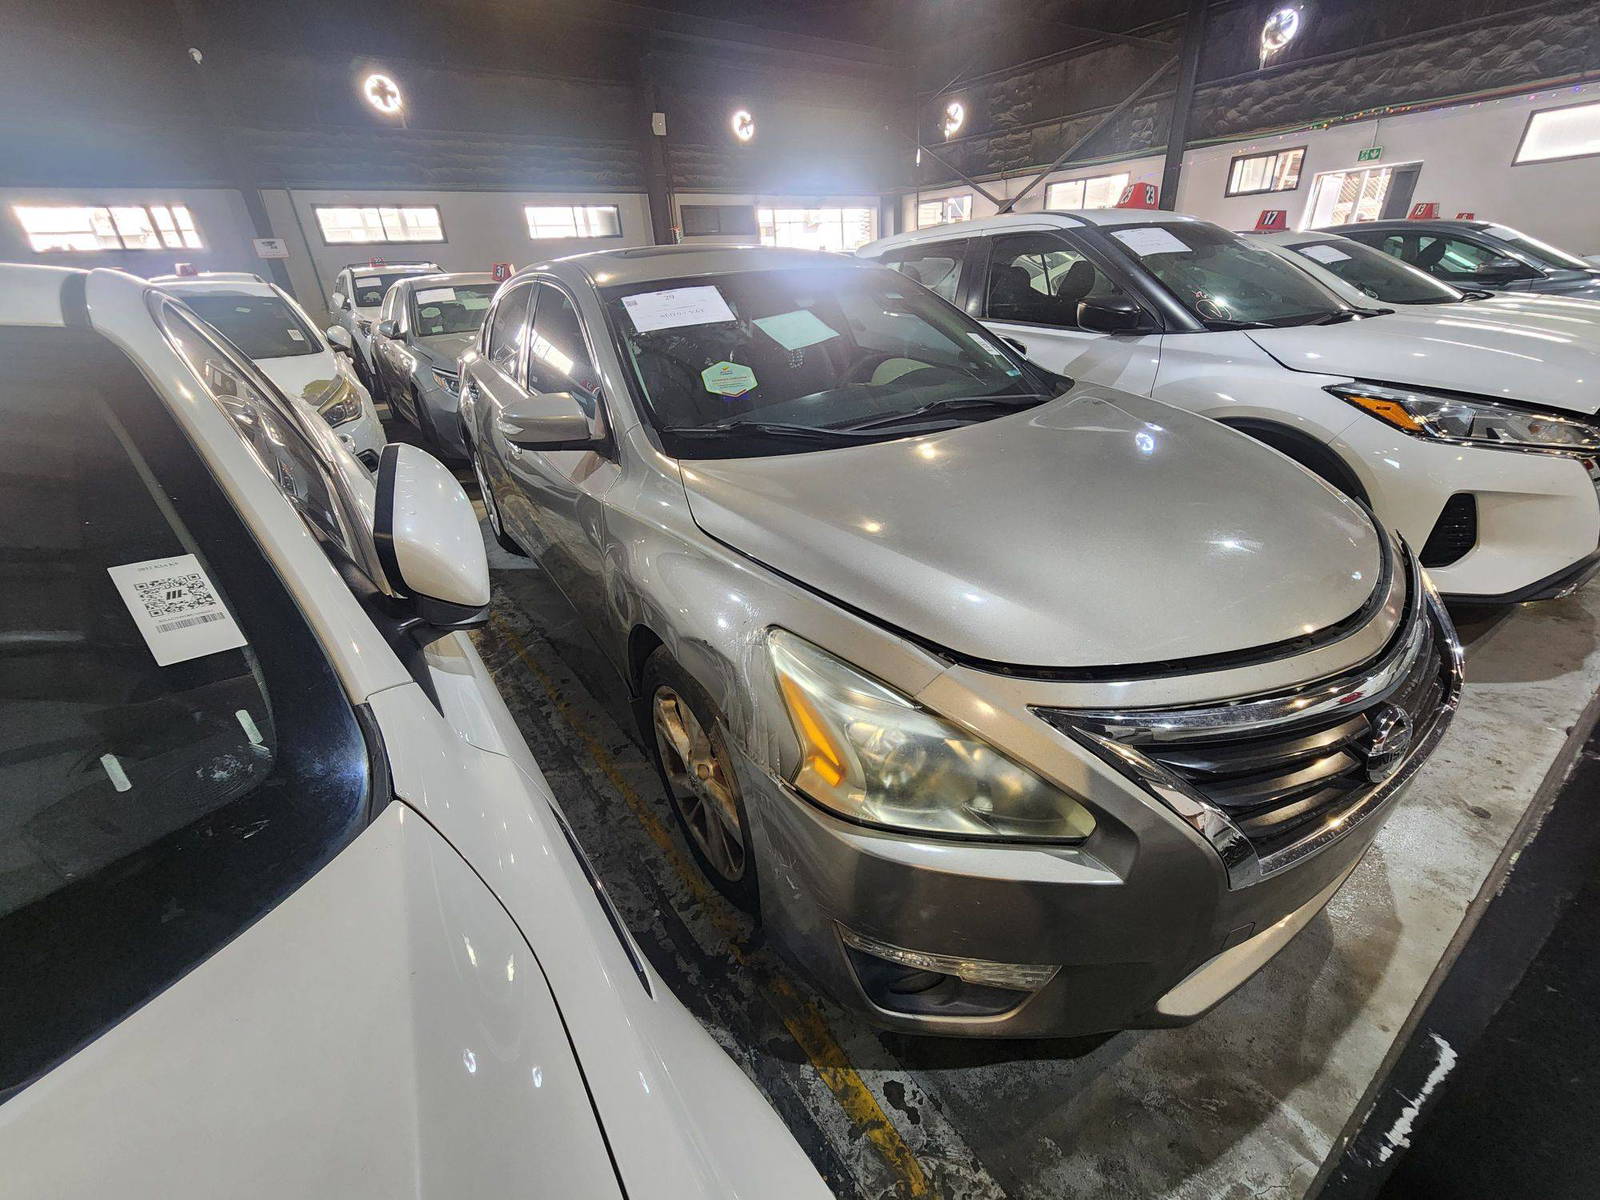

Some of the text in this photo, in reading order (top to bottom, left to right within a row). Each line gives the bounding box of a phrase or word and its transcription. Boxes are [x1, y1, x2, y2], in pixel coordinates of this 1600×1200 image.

[1146, 185, 1155, 205] 23
[1263, 211, 1279, 225] 17
[496, 265, 505, 278] 31
